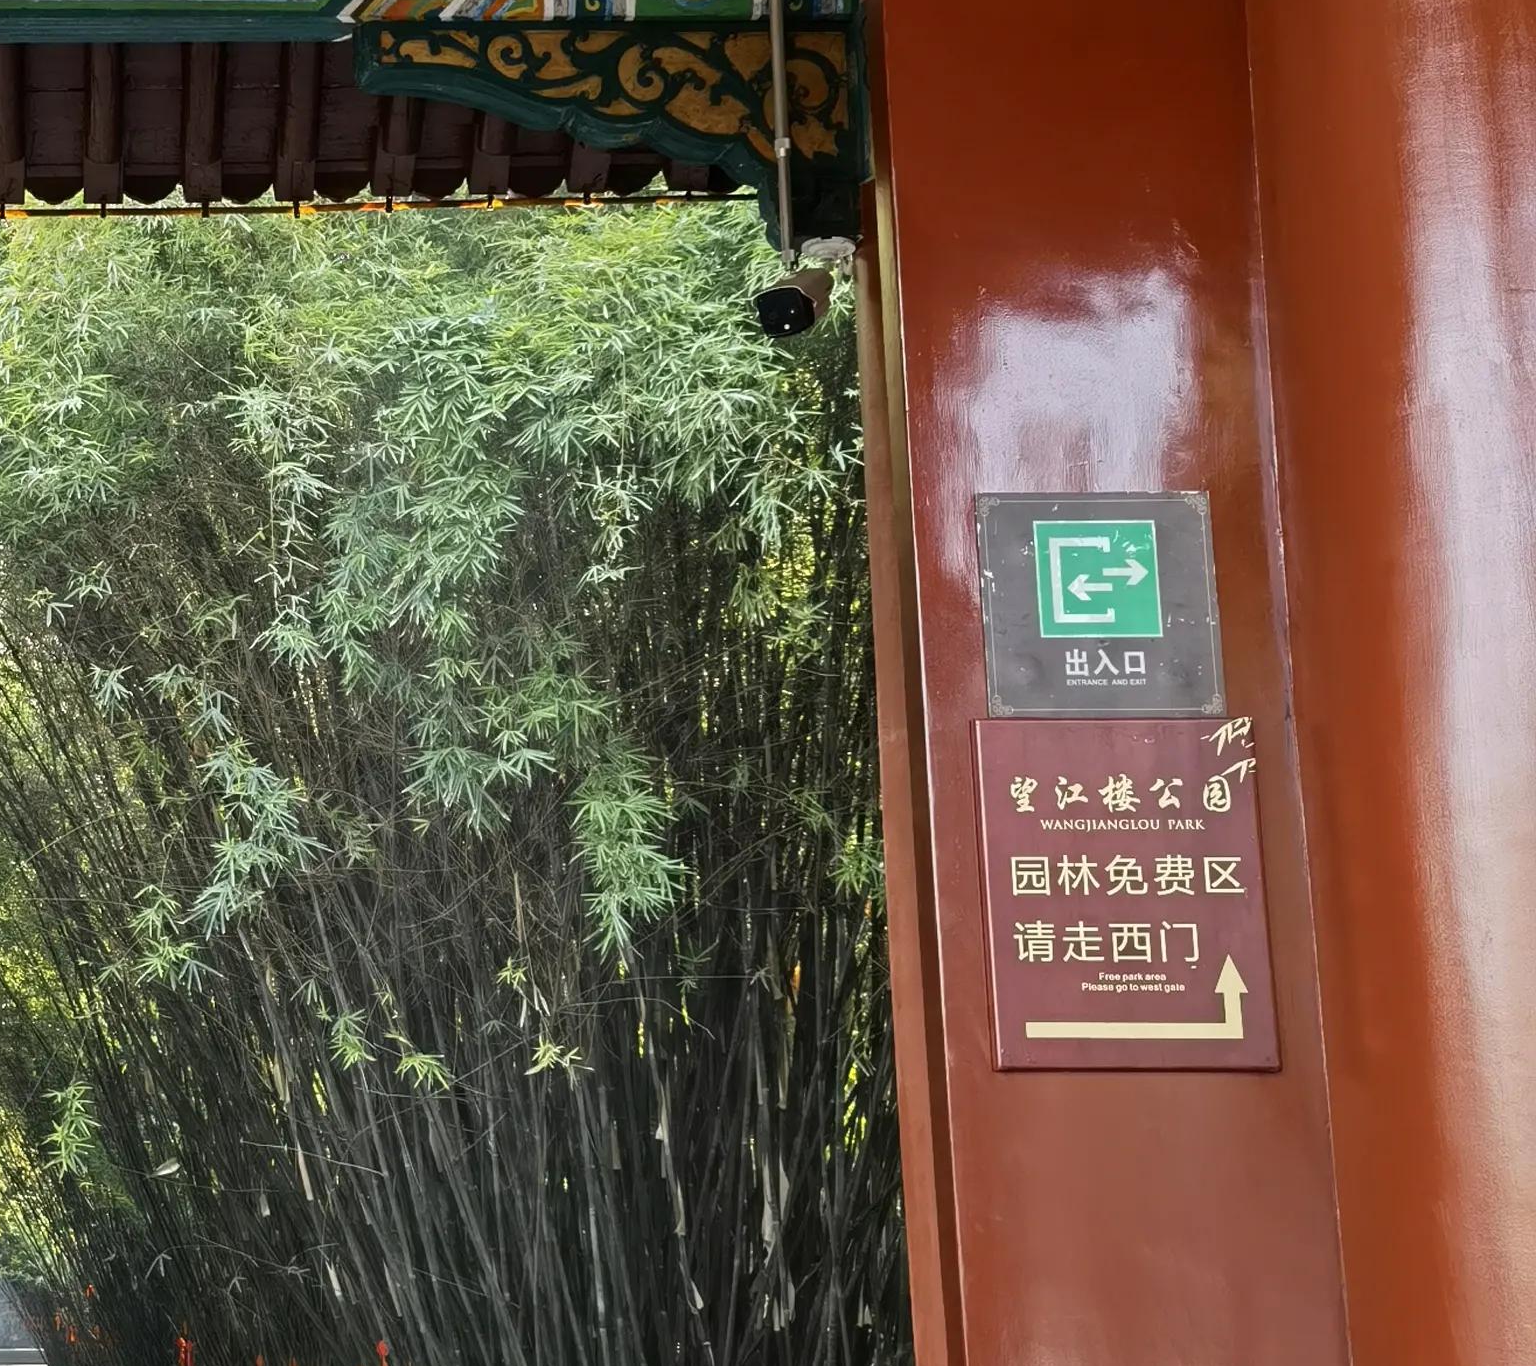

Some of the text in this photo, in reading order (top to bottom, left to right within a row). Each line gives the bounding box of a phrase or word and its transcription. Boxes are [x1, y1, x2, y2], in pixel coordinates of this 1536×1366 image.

[1065, 648, 1146, 676] 出入口
[1066, 678, 1146, 686] ENTRANCE AND EXIT
[1010, 773, 1232, 813] 望江楼公园
[1040, 819, 1206, 832] WANGJIANGLOU PARK
[1011, 854, 1246, 896] 园林免费区
[1013, 920, 1200, 963] 请走西门
[1099, 972, 1121, 981] Free
[1122, 972, 1143, 982] park
[1082, 983, 1114, 992] Please
[1115, 985, 1128, 994] go
[1129, 983, 1139, 992] to
[1140, 984, 1163, 992] west
